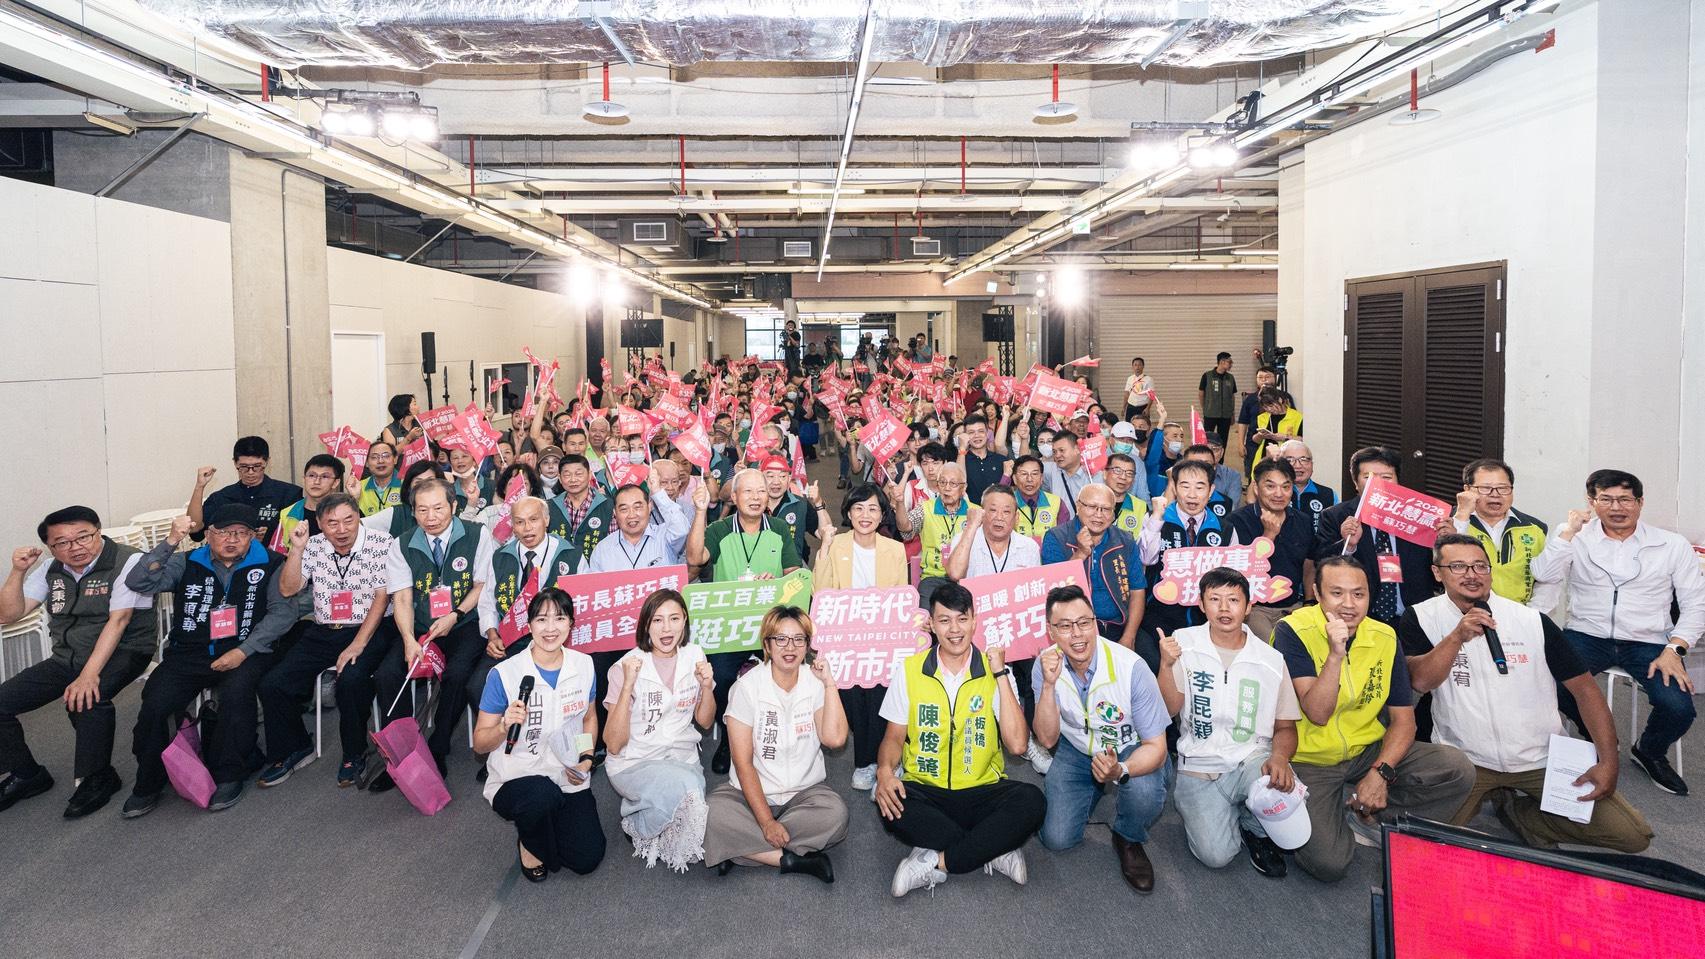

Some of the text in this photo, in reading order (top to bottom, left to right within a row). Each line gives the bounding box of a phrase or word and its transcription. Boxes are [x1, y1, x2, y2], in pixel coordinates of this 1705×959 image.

[1368, 492, 1438, 531] 新北慧贏
[1414, 500, 1445, 515] 2026
[1165, 548, 1253, 578] 慧做事
[689, 585, 777, 611] 百工百業
[815, 593, 913, 626] 新時代
[975, 578, 1046, 614] 溫暖 創新
[817, 630, 918, 644] NEW TAIPEI CITY
[762, 710, 779, 760] 黃淑君
[917, 704, 940, 778] 陳俊諺
[975, 716, 986, 749] 板橋
